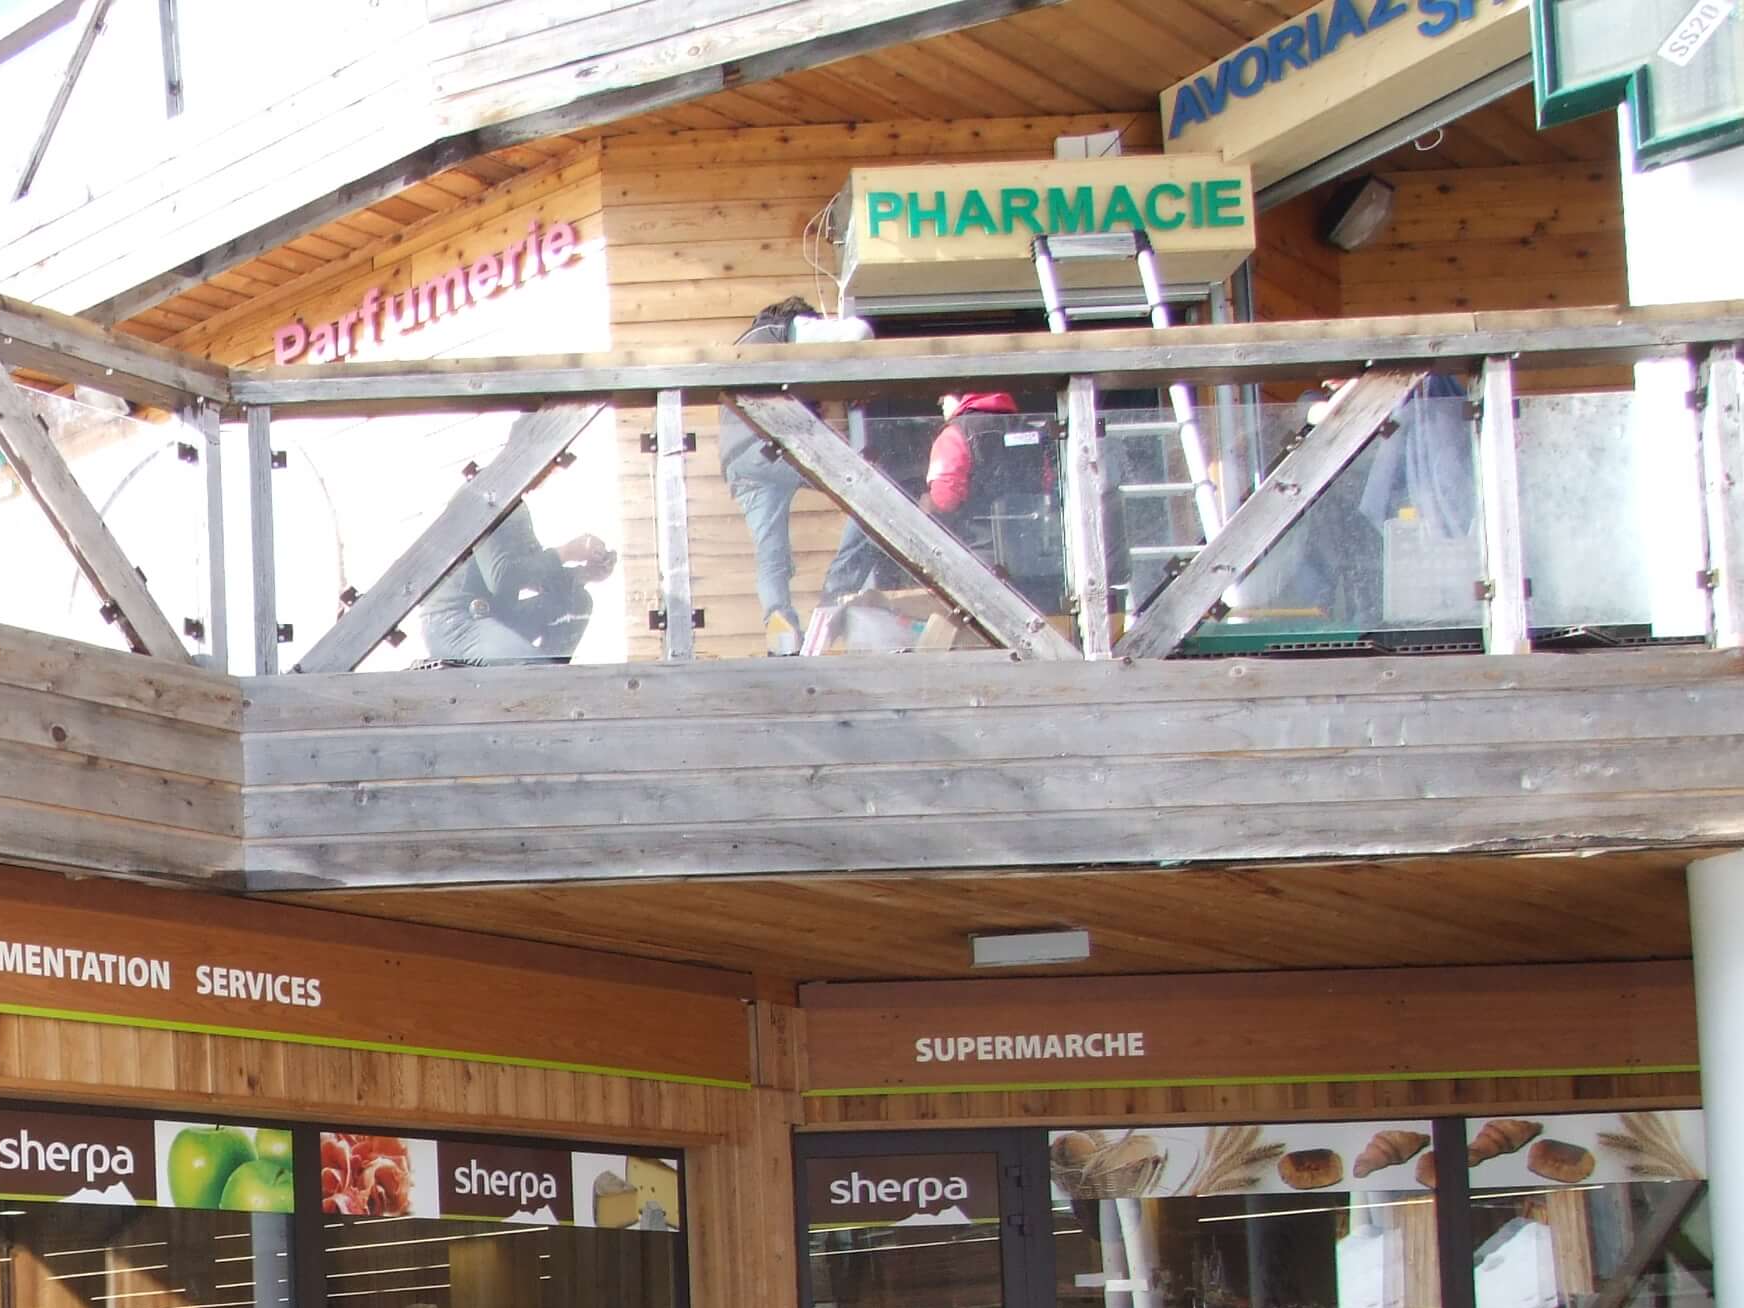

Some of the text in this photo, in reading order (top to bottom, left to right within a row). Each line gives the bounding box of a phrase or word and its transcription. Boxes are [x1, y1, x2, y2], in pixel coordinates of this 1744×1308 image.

[865, 178, 1246, 238] PHARMACIE
[272, 218, 580, 366] Parfumerie
[195, 964, 322, 1008] SERVICES
[915, 1032, 1145, 1063] SUPERMARCHE
[454, 1159, 557, 1205] sherpa
[829, 1171, 969, 1208] sherpa
